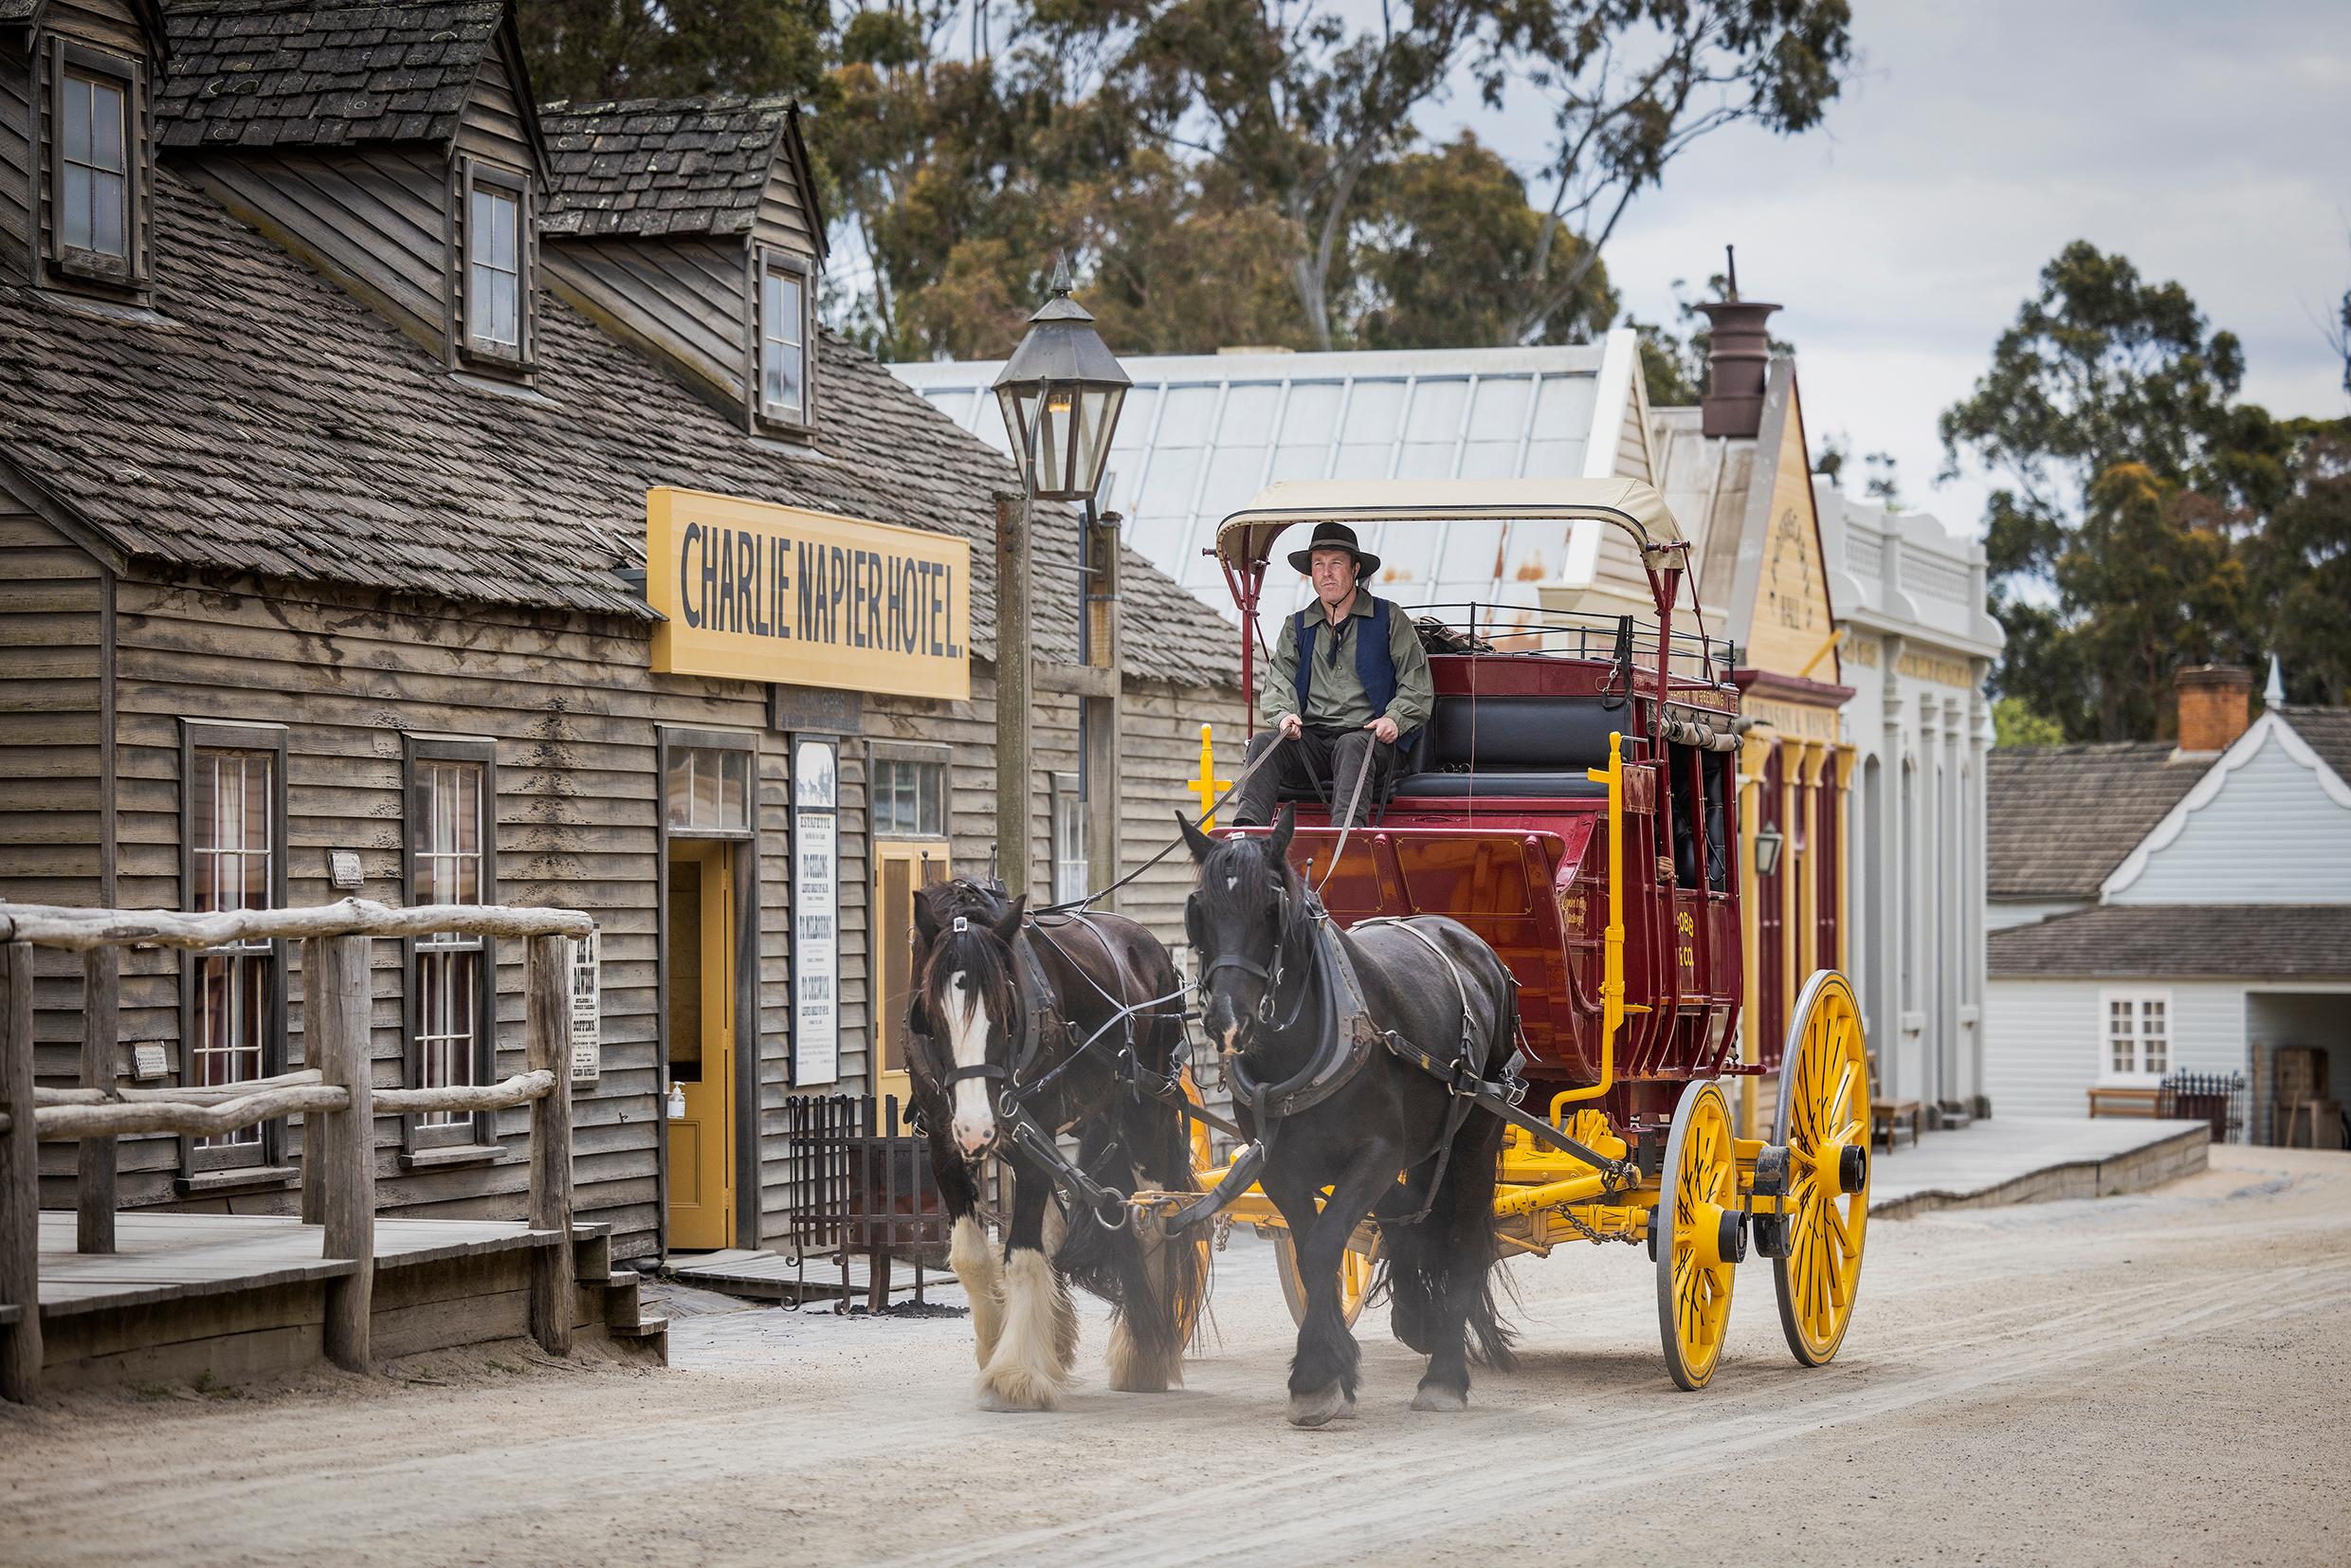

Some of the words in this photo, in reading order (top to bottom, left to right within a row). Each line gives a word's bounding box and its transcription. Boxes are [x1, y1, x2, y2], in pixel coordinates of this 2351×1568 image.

[681, 521, 791, 639] CHARLIE
[797, 540, 884, 650] NAPIER
[887, 555, 963, 660] HOTEL.
[1699, 690, 1724, 707] GEELONG
[800, 816, 830, 829] ESTAFETTE
[806, 915, 831, 940] MELBOURNE
